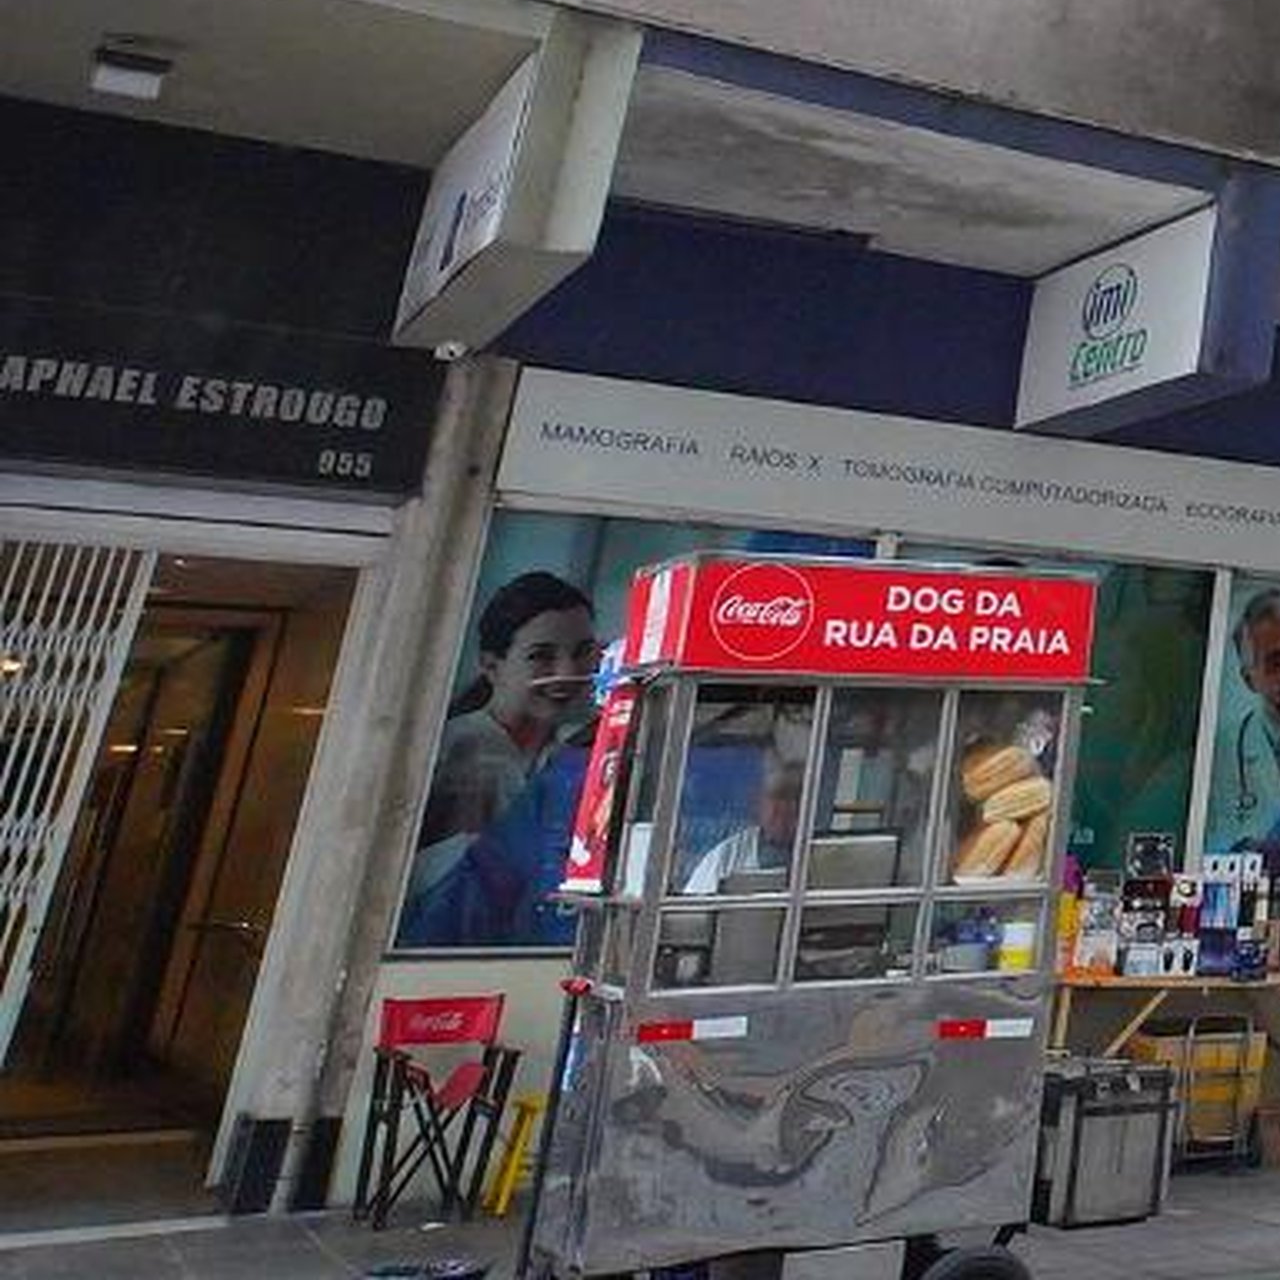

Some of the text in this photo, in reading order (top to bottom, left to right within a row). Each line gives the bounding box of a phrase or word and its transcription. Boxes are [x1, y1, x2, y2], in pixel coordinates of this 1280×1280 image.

[175, 375, 388, 430] ESTROUGO
[318, 449, 374, 478] 955
[540, 421, 699, 456] MAMOGRAFIA
[730, 444, 798, 470] RAIOS
[806, 454, 823, 471] X
[886, 585, 1023, 617] DOG DA
[824, 619, 1070, 655] RUA DA PRAIA
